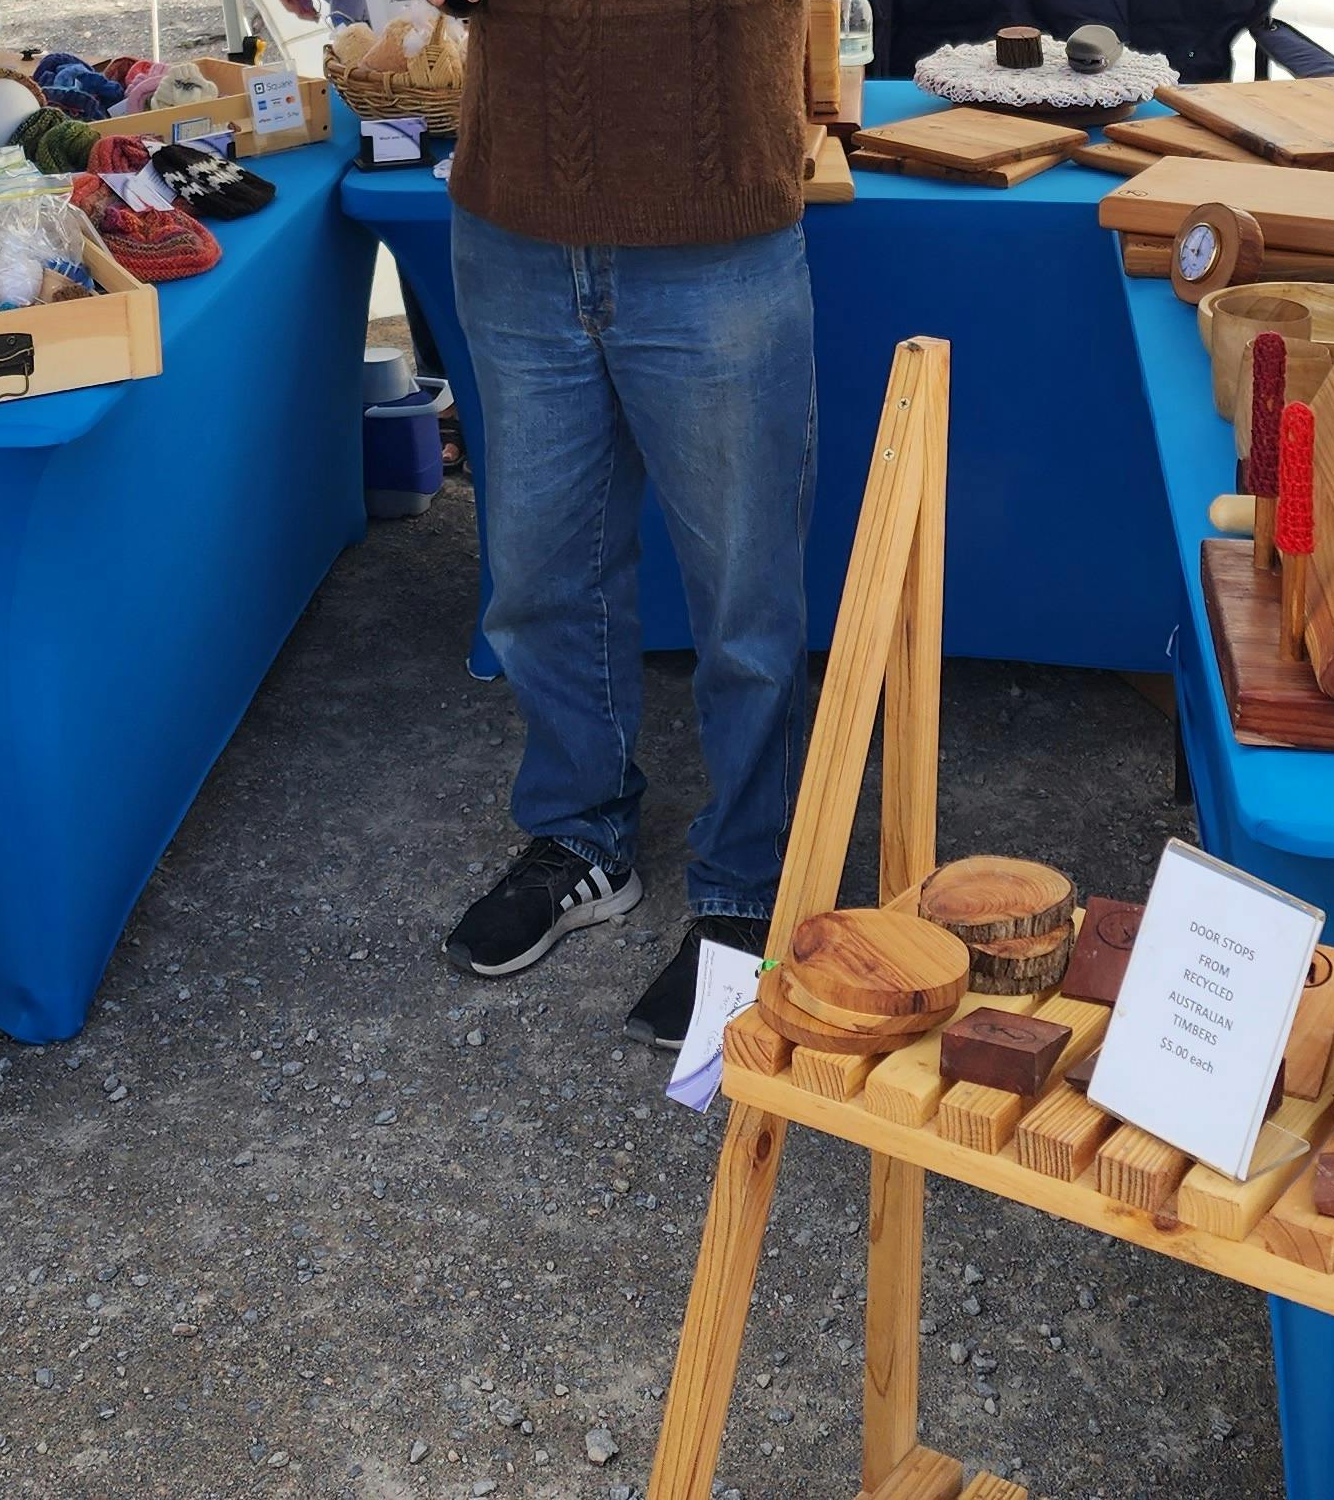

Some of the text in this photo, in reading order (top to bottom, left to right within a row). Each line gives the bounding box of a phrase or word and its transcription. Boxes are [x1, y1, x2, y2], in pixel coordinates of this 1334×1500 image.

[1189, 921, 1256, 962] DOOR STOPS
[1198, 954, 1231, 978] FROM
[1183, 968, 1234, 1002] RECYCLED
[1168, 990, 1234, 1032] AUSTRALIAN
[1172, 1013, 1219, 1046] TIMBERS
[1160, 1036, 1215, 1075] $5.00 each
